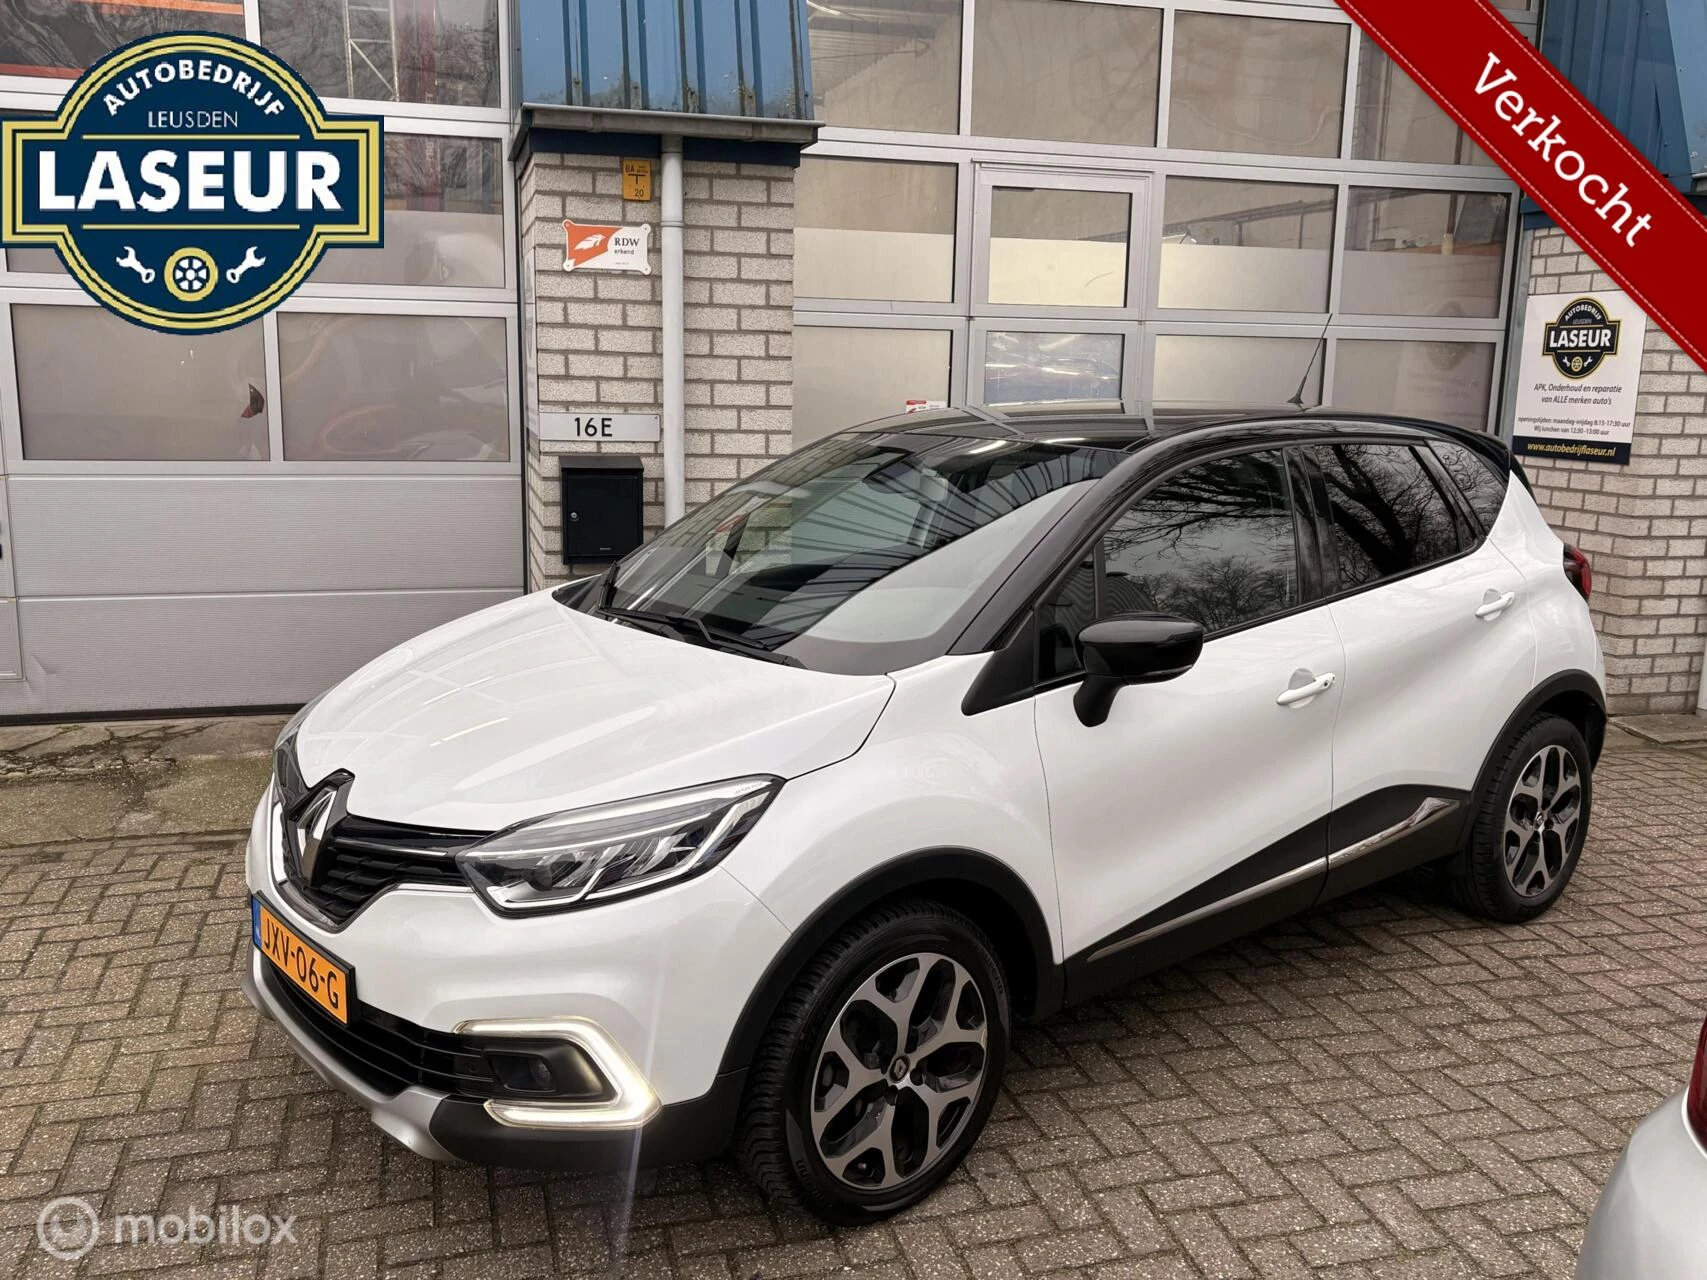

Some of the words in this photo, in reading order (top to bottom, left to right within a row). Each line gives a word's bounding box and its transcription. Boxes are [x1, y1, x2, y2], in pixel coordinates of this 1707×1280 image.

[634, 188, 645, 198] 20
[614, 237, 640, 247] RDW
[1564, 304, 1602, 322] AUTOBEDRIJF
[1549, 329, 1612, 348] LASEUR
[1533, 383, 1547, 392] APK,
[1548, 383, 1582, 392] Onderhoud
[1591, 385, 1623, 394] reparatie
[1553, 395, 1568, 403] ALLE
[1568, 397, 1592, 405] merken
[1592, 397, 1612, 405] auto's
[574, 417, 613, 437] 16E
[1527, 442, 1616, 457] www.autobedrijflaseur.nl
[264, 918, 339, 1009] JXV-06-G
